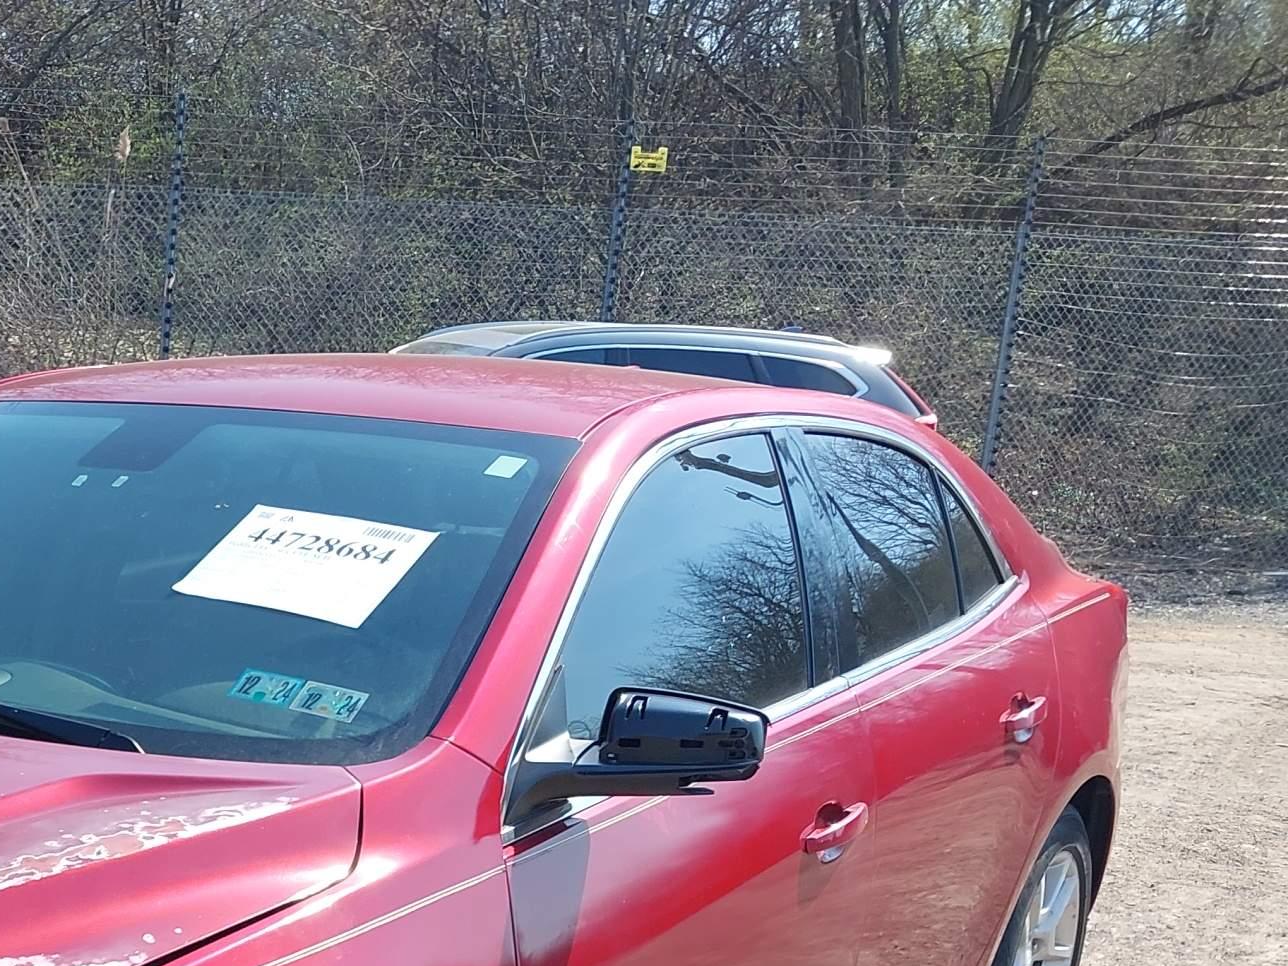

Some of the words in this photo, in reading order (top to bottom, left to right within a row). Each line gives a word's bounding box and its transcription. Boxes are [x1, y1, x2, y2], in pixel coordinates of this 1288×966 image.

[248, 528, 397, 564] 44728684
[237, 675, 261, 695] 12
[272, 681, 297, 702] 24
[301, 692, 322, 710] 12
[336, 695, 361, 719] 24
